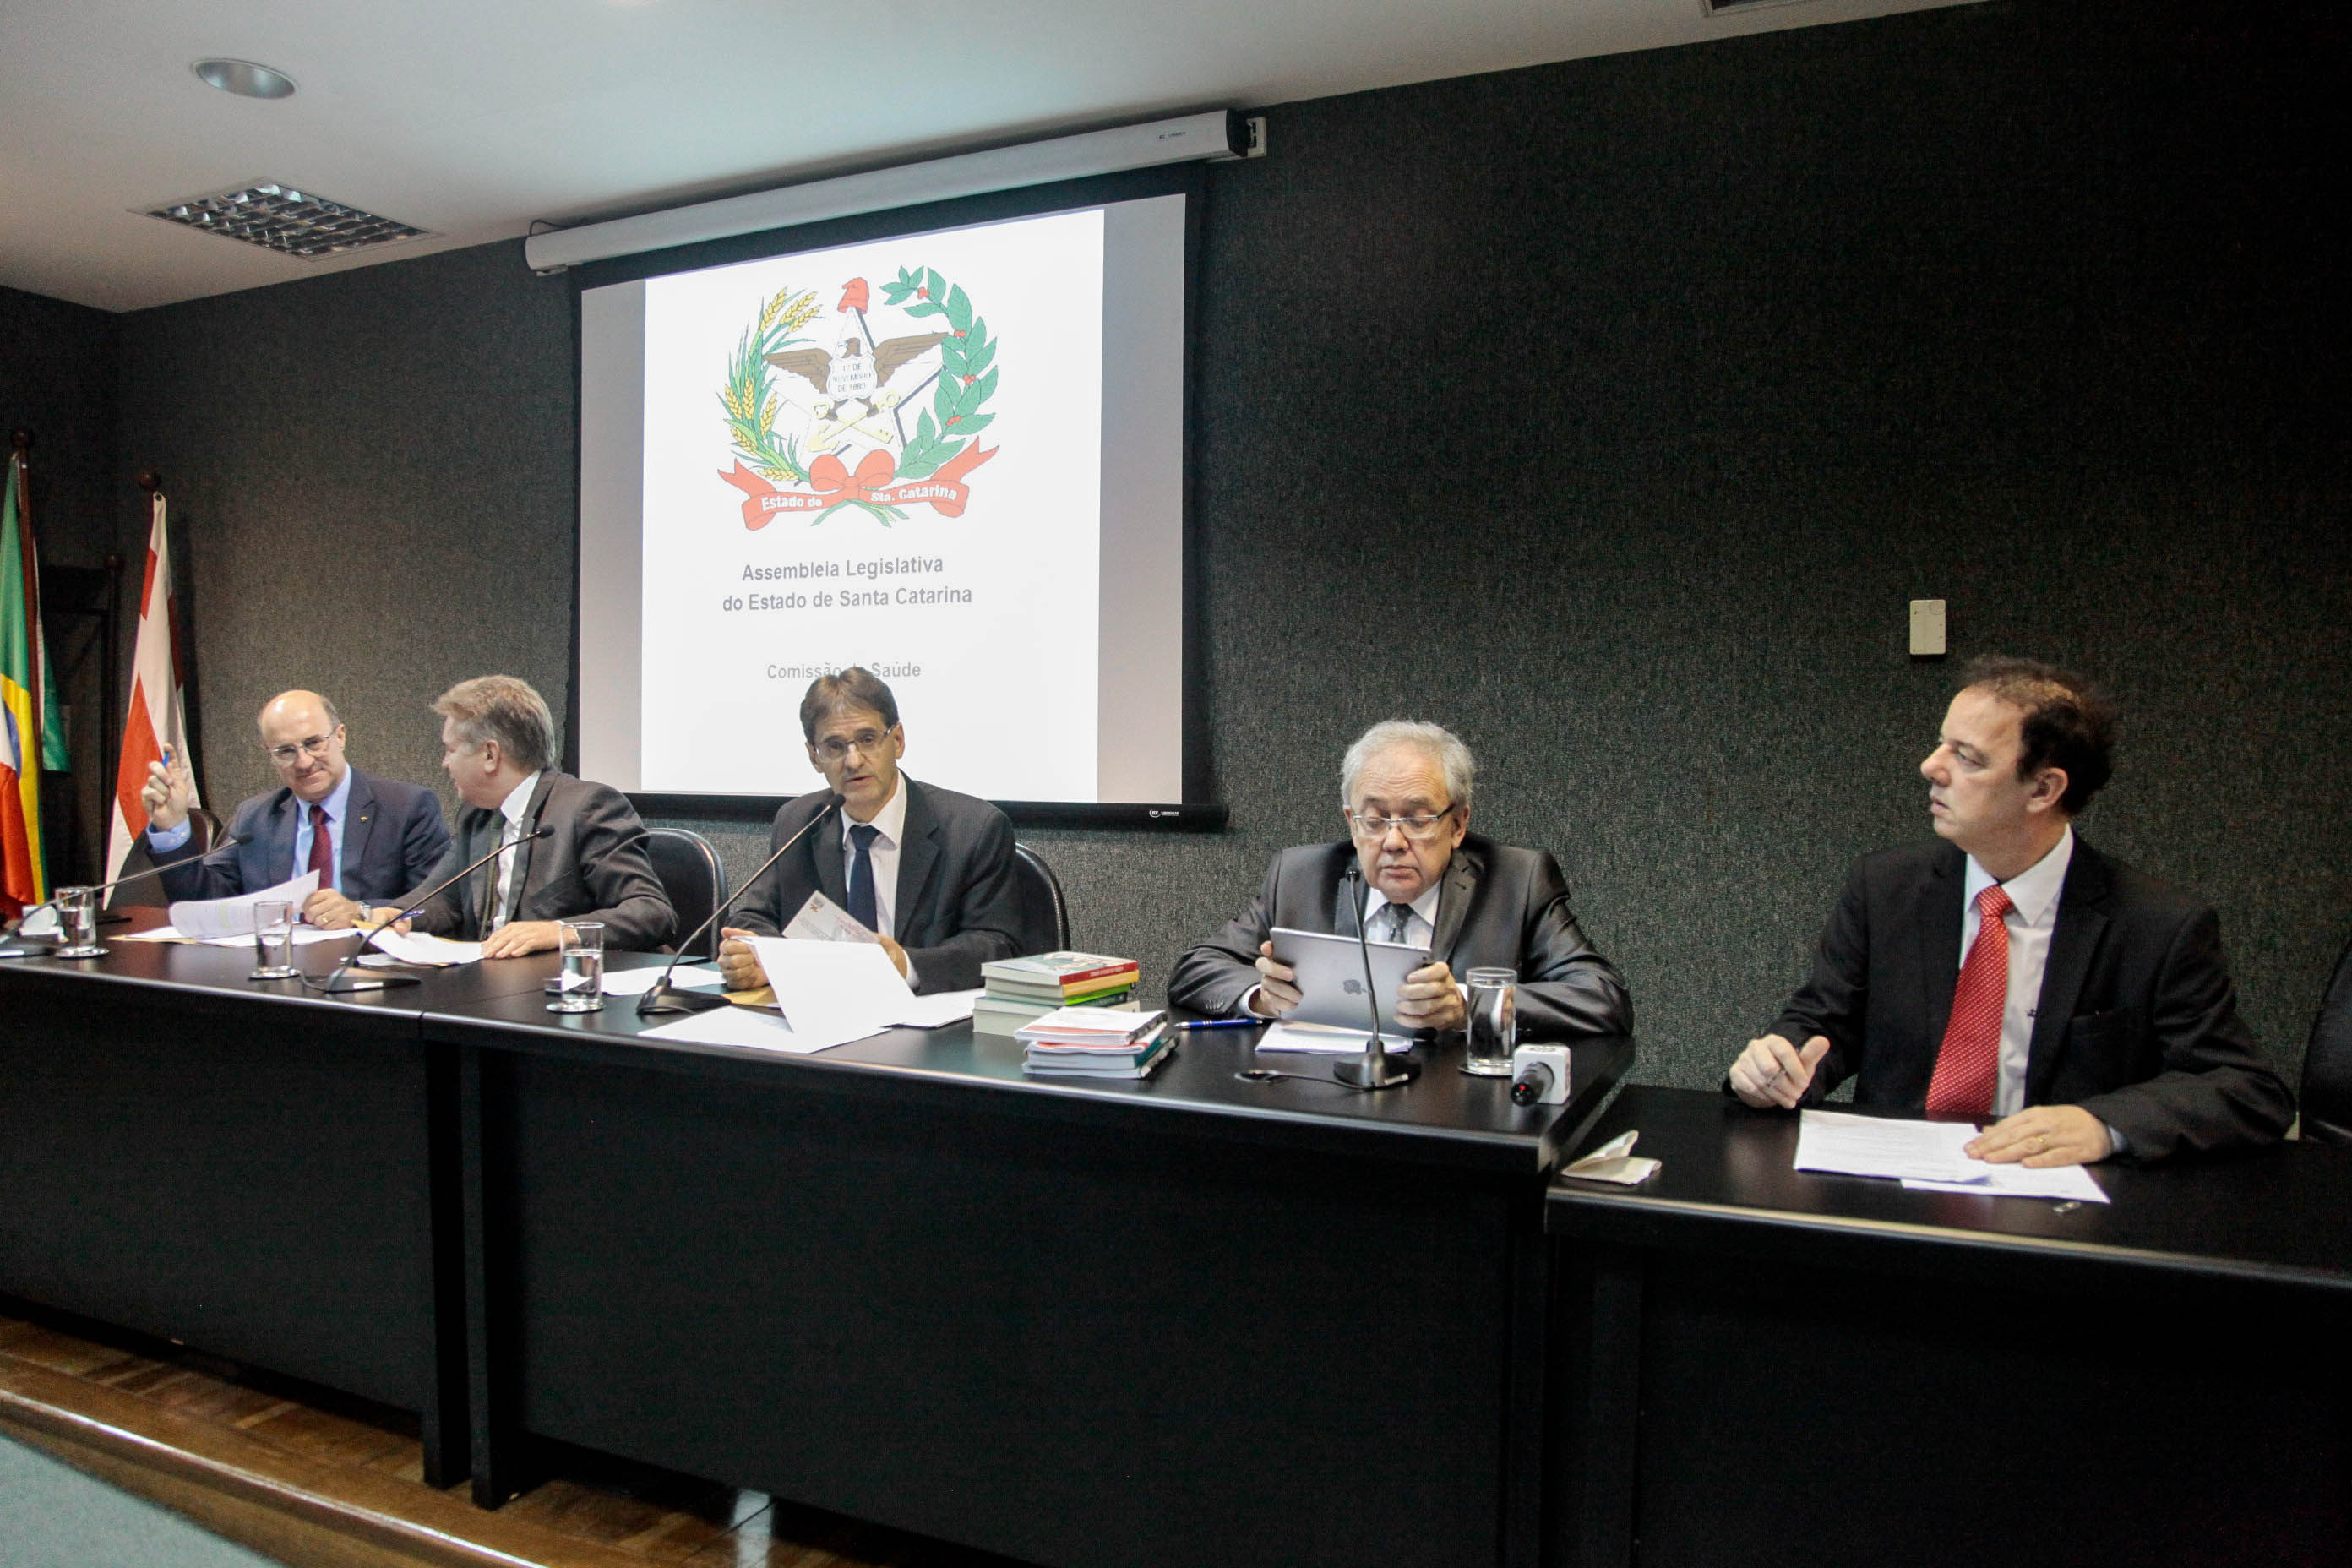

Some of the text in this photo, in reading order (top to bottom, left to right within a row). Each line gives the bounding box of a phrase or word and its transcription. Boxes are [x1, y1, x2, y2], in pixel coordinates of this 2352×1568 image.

[761, 485, 958, 511] Estado de Sta. Catarina
[742, 556, 944, 581] Assembleia Legislativa
[722, 585, 972, 611] do Estado de Santa Catarina
[766, 661, 922, 679] Comissão Saúde
